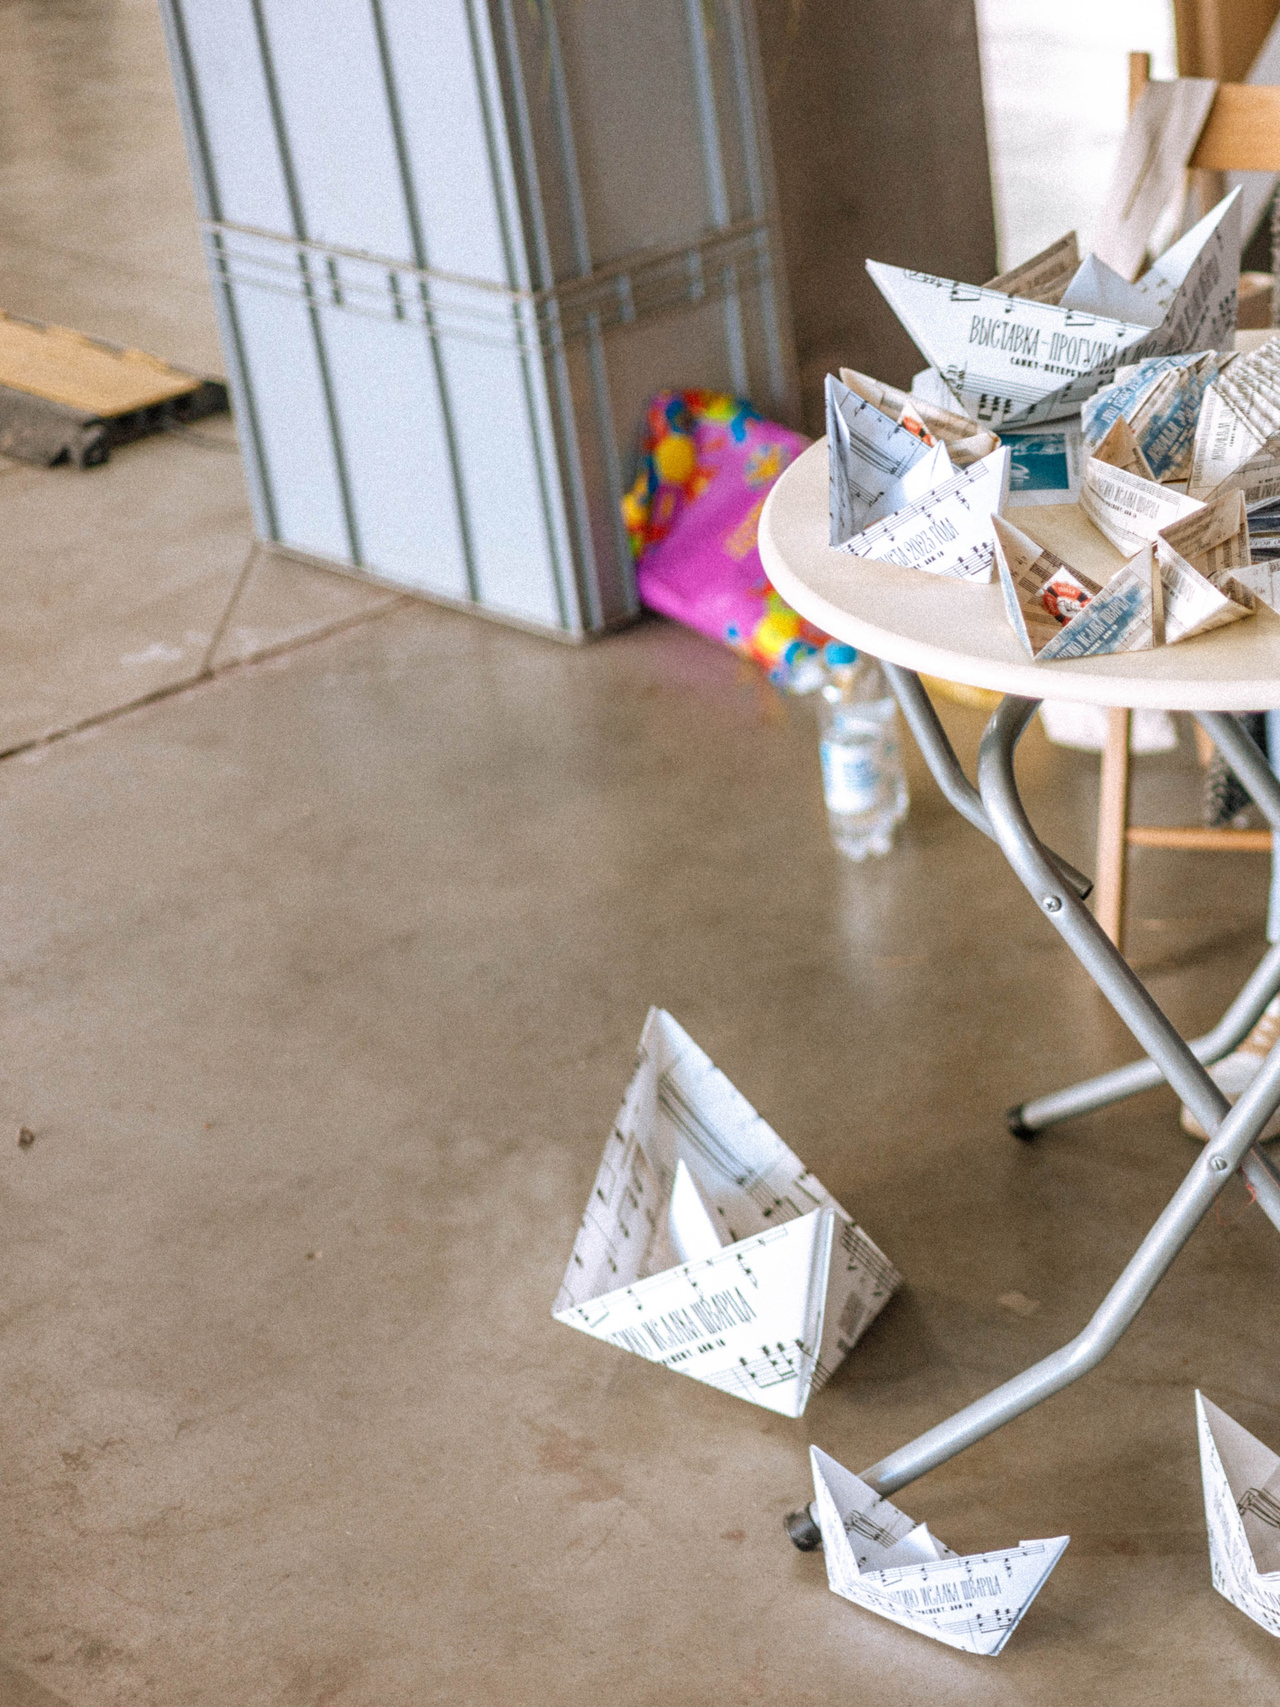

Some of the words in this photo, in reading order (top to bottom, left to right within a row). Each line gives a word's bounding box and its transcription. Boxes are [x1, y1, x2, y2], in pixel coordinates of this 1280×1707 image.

[904, 532, 937, 561] 2023
[930, 517, 960, 545] ГОДА
[1076, 619, 1107, 647] ИСААКА
[1100, 594, 1131, 625] ШВАРЦА
[641, 1307, 703, 1351] ИСААКА
[690, 1286, 757, 1335] ШВАРЦА
[920, 1581, 960, 1607] ИСААКА
[960, 1575, 1002, 1601] ШВАРЦА
